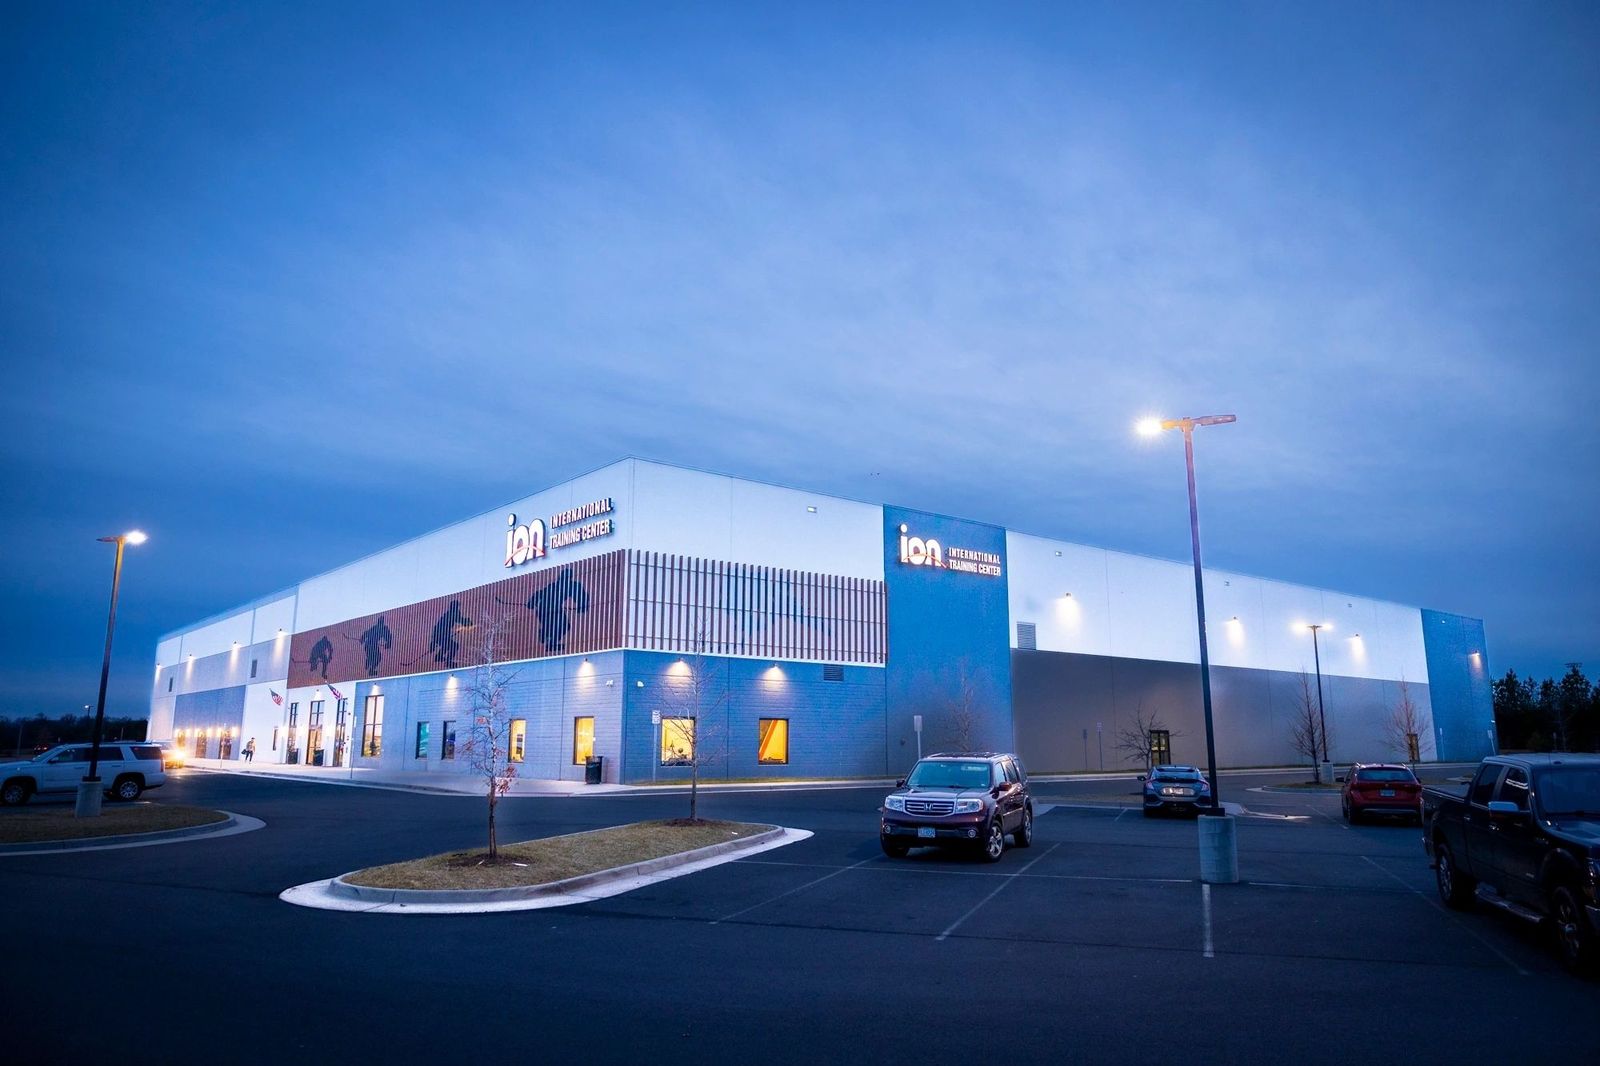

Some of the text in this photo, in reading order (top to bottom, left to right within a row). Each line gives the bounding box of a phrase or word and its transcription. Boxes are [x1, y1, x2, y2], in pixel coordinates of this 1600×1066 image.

[550, 498, 612, 529] INTERNATIONAL
[505, 513, 545, 568] ion
[550, 519, 611, 549] TRAINING CENTER
[900, 523, 942, 567] ion
[948, 547, 1001, 564] INTERNATIONAL
[949, 559, 1002, 577] TRAINING CENTER
